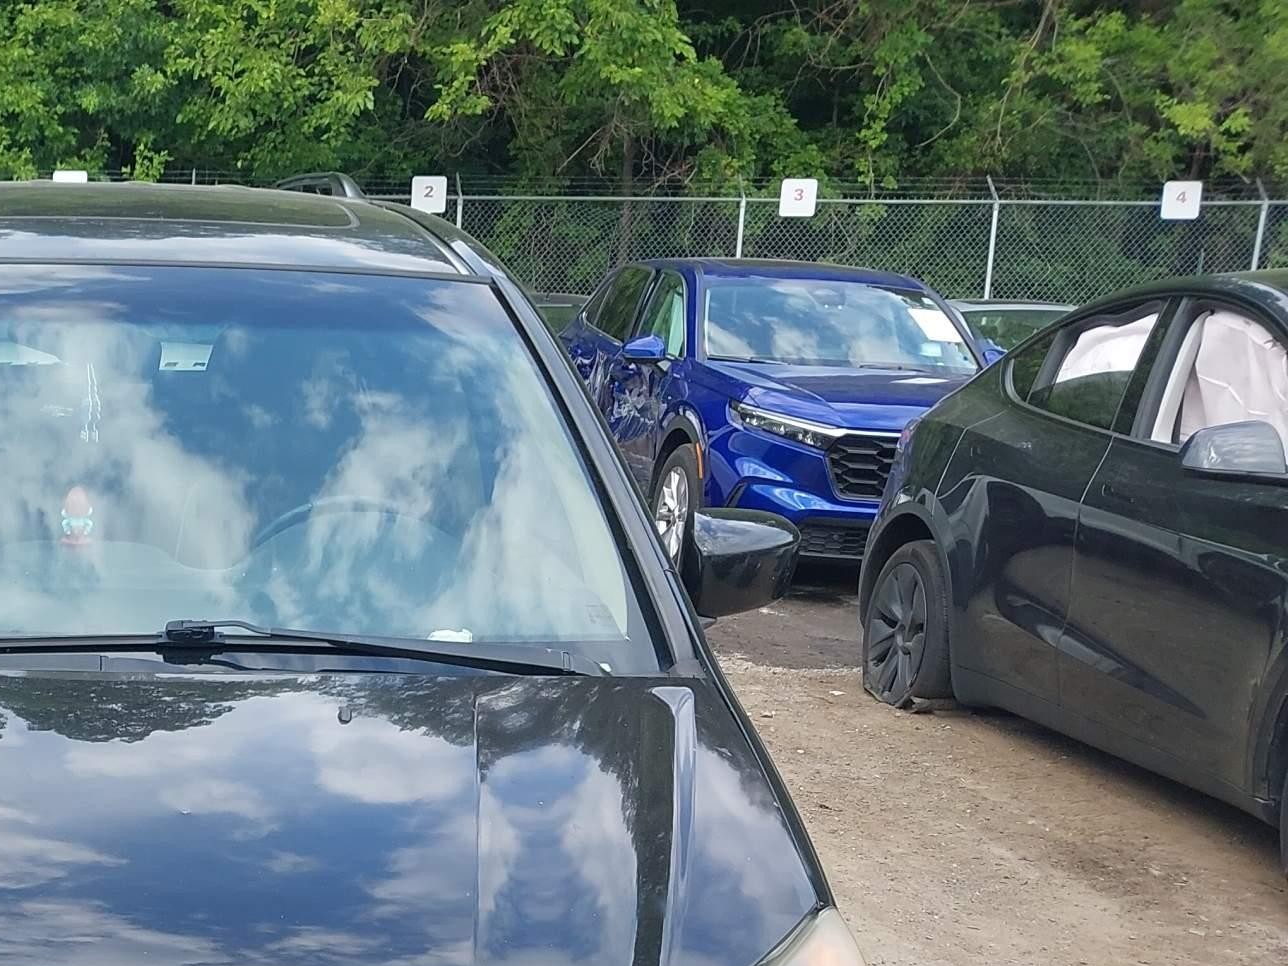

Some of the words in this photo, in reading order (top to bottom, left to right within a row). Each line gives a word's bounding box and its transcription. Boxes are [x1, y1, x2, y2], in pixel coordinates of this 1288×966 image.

[423, 185, 434, 198] 2
[794, 188, 804, 201] 3
[1175, 191, 1187, 203] 4
